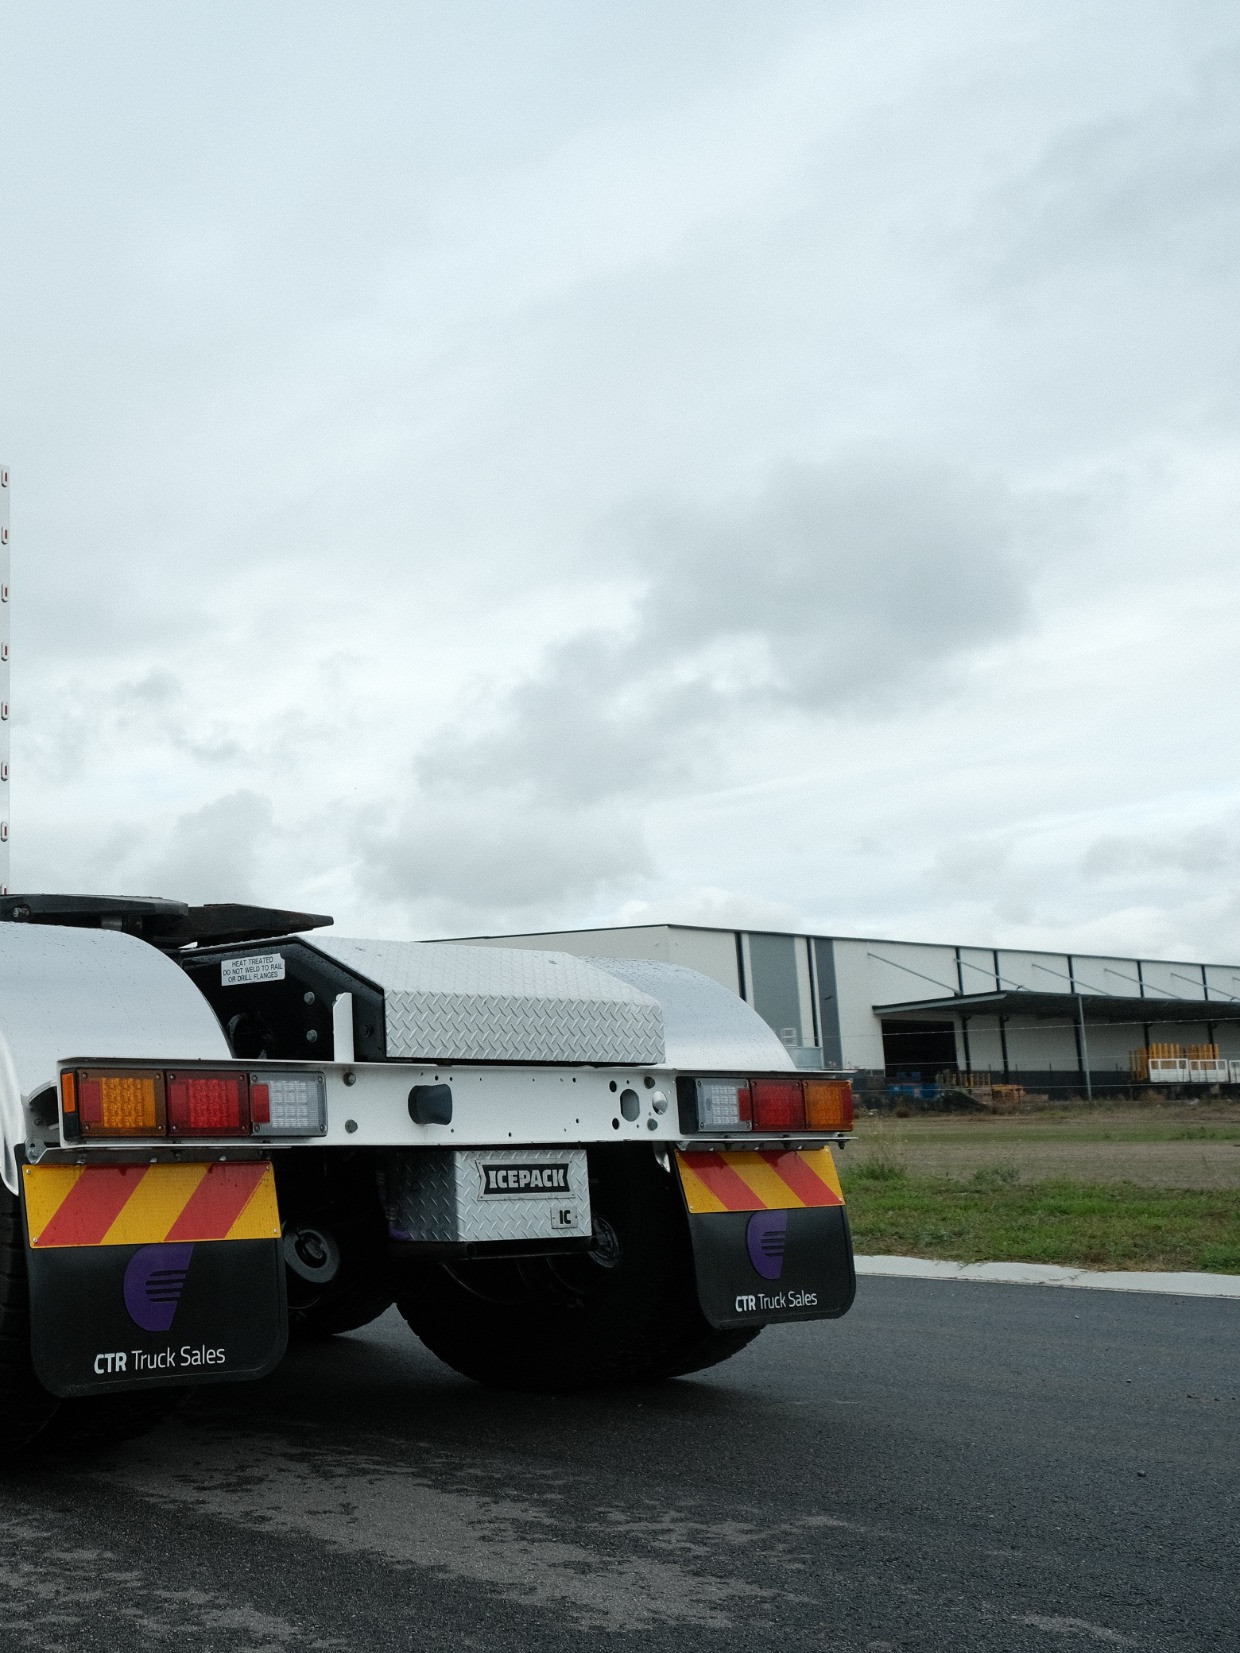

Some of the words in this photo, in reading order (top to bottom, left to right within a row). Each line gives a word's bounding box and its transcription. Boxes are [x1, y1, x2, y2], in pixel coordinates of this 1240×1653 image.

[249, 957, 273, 965] TREATED
[254, 971, 278, 979] FLANGES
[488, 1169, 565, 1189] ICEPACK
[559, 1210, 571, 1225] IC
[735, 1294, 756, 1312] CTR
[758, 1292, 787, 1310] Truck
[788, 1290, 818, 1307] Sales
[93, 1352, 127, 1375] CTR
[131, 1347, 176, 1371] Truck
[180, 1344, 226, 1367] Sales
